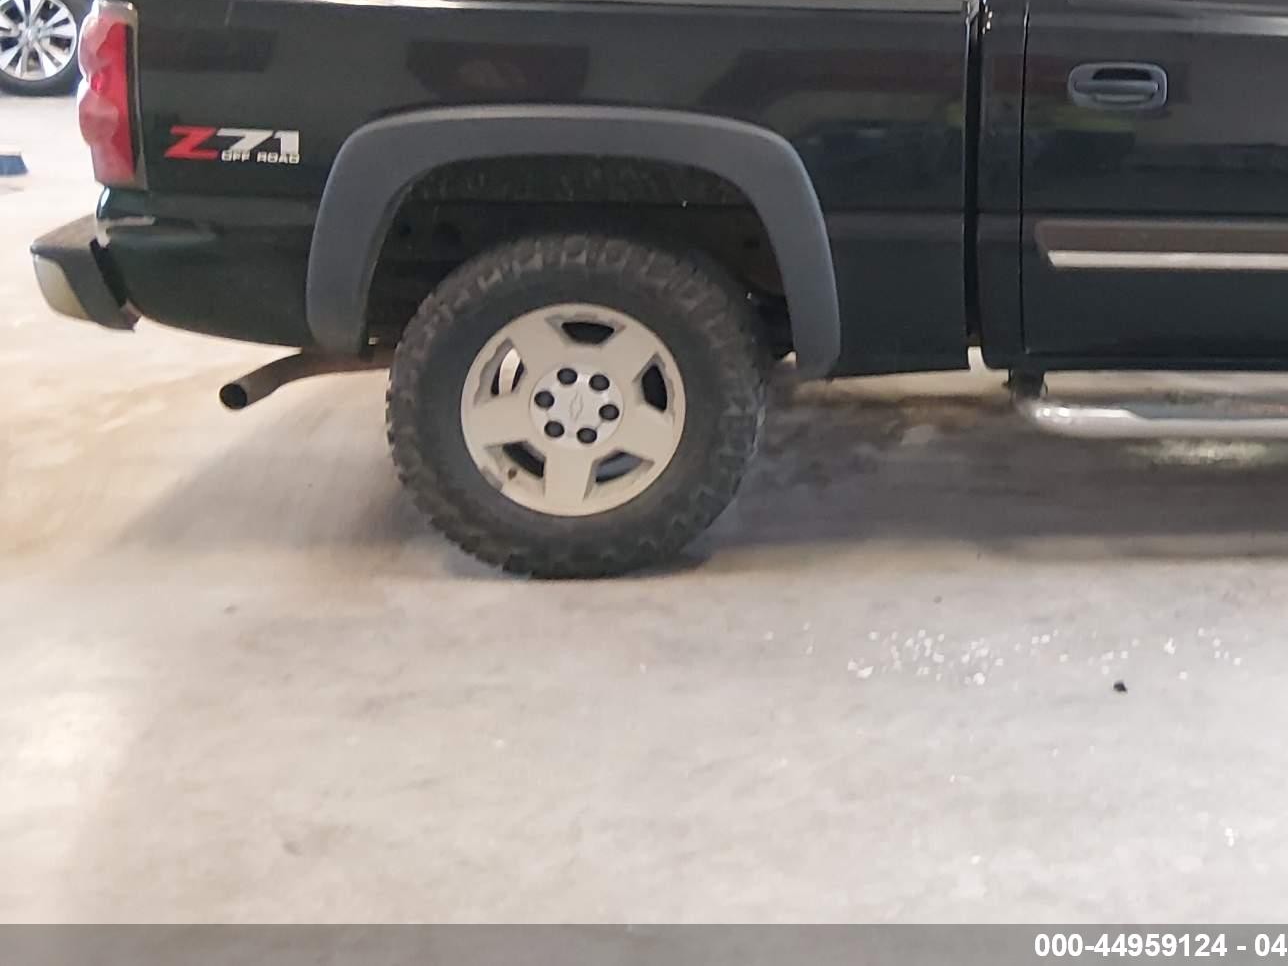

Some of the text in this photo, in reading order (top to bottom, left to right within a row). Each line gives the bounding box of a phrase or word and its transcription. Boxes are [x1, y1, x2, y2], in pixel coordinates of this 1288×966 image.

[164, 125, 300, 160] Z71
[221, 150, 300, 164] OFF ROAD
